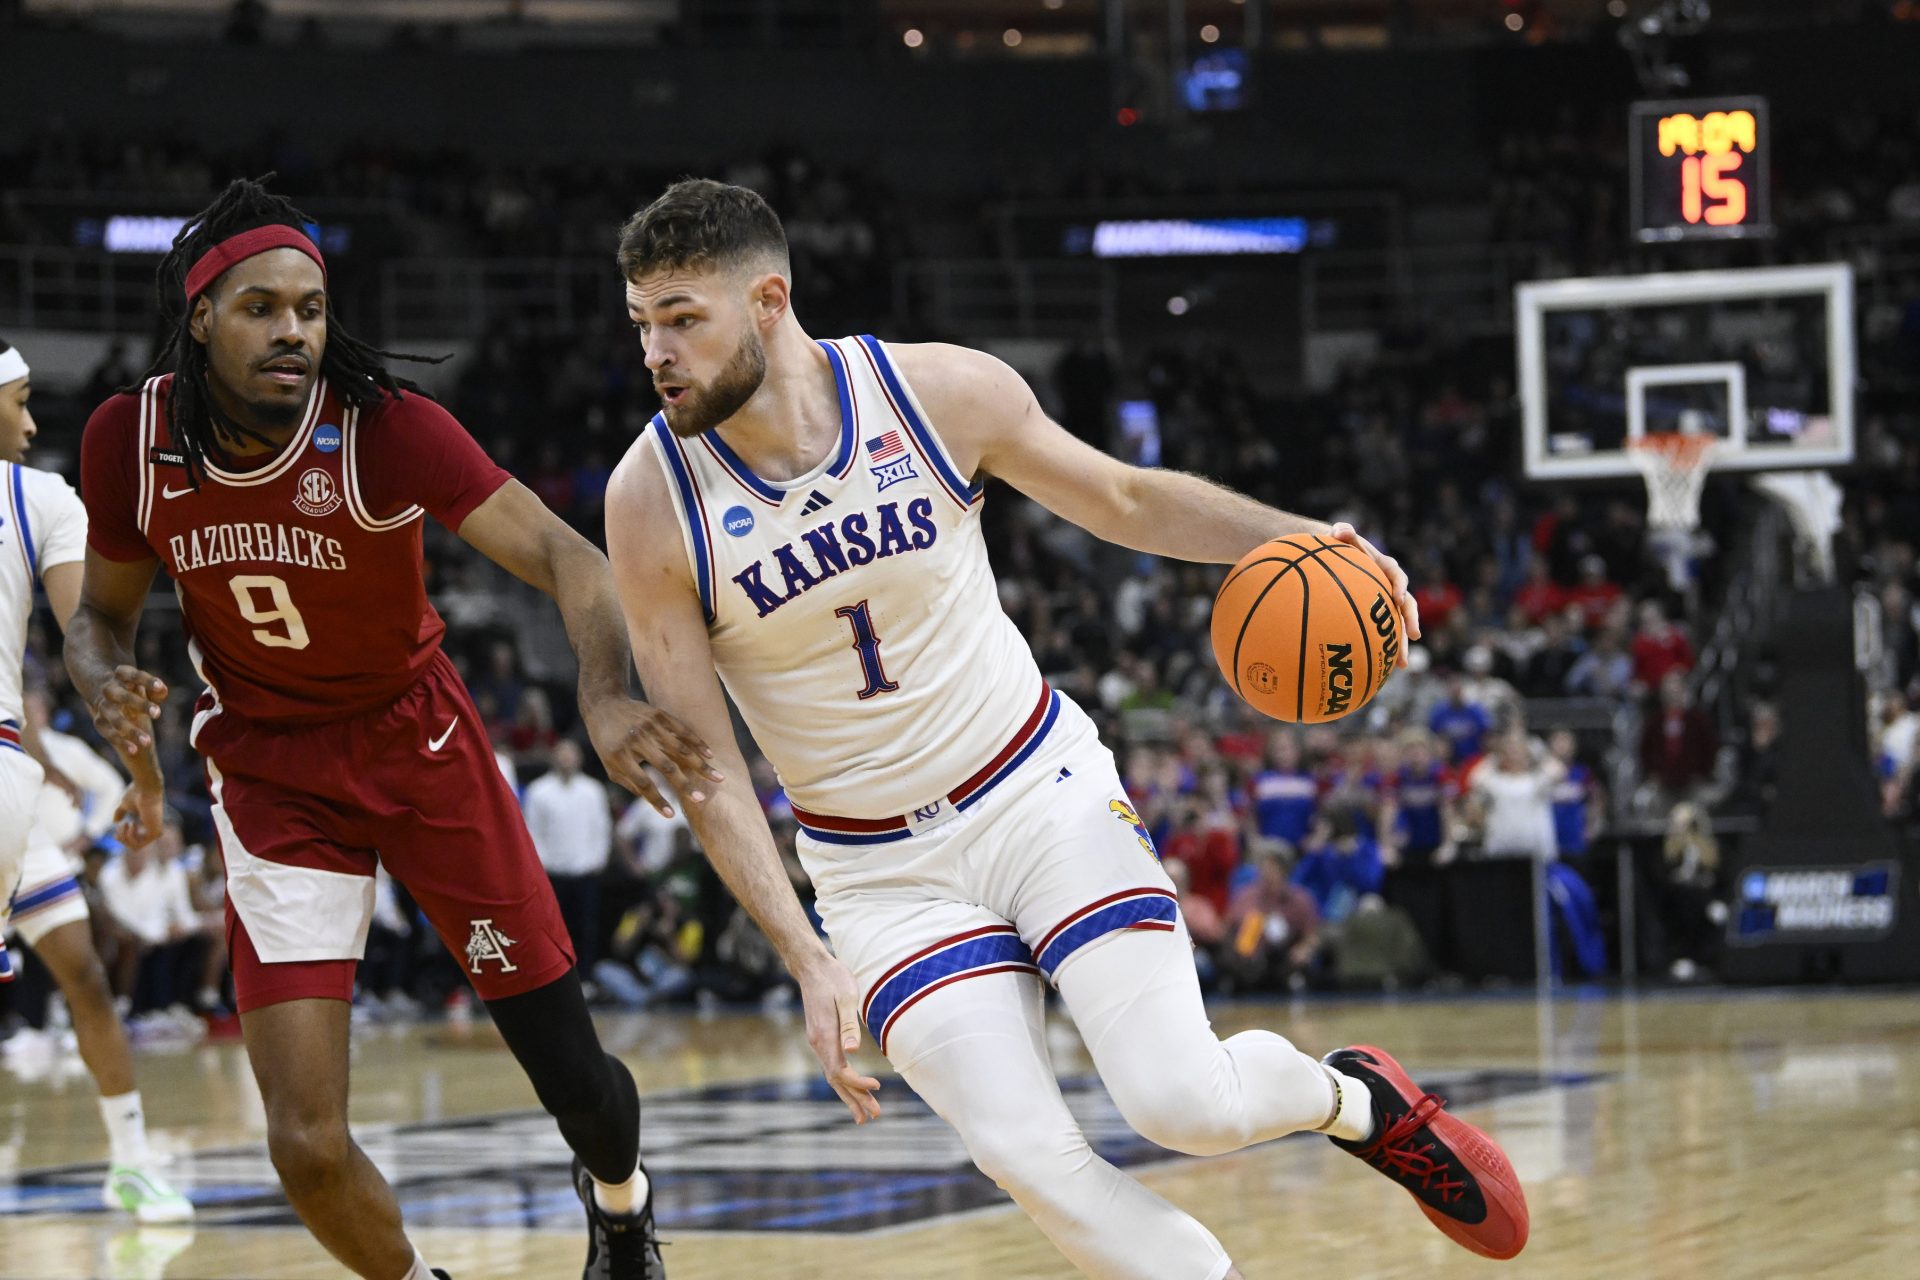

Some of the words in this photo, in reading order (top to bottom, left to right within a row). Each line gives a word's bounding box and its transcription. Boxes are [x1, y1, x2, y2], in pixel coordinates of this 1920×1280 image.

[1682, 152, 1746, 225] 15
[316, 437, 340, 446] NCAA
[302, 472, 330, 502] SEC
[870, 453, 919, 492] XII
[301, 503, 335, 514] GRADUATE
[728, 517, 753, 531] NCAA
[169, 523, 347, 573] RAZORBACKS
[732, 497, 937, 619] KANSAS
[229, 575, 310, 650] 9
[835, 599, 899, 700] 1
[1324, 643, 1353, 716] NCAA
[914, 801, 940, 823] KU
